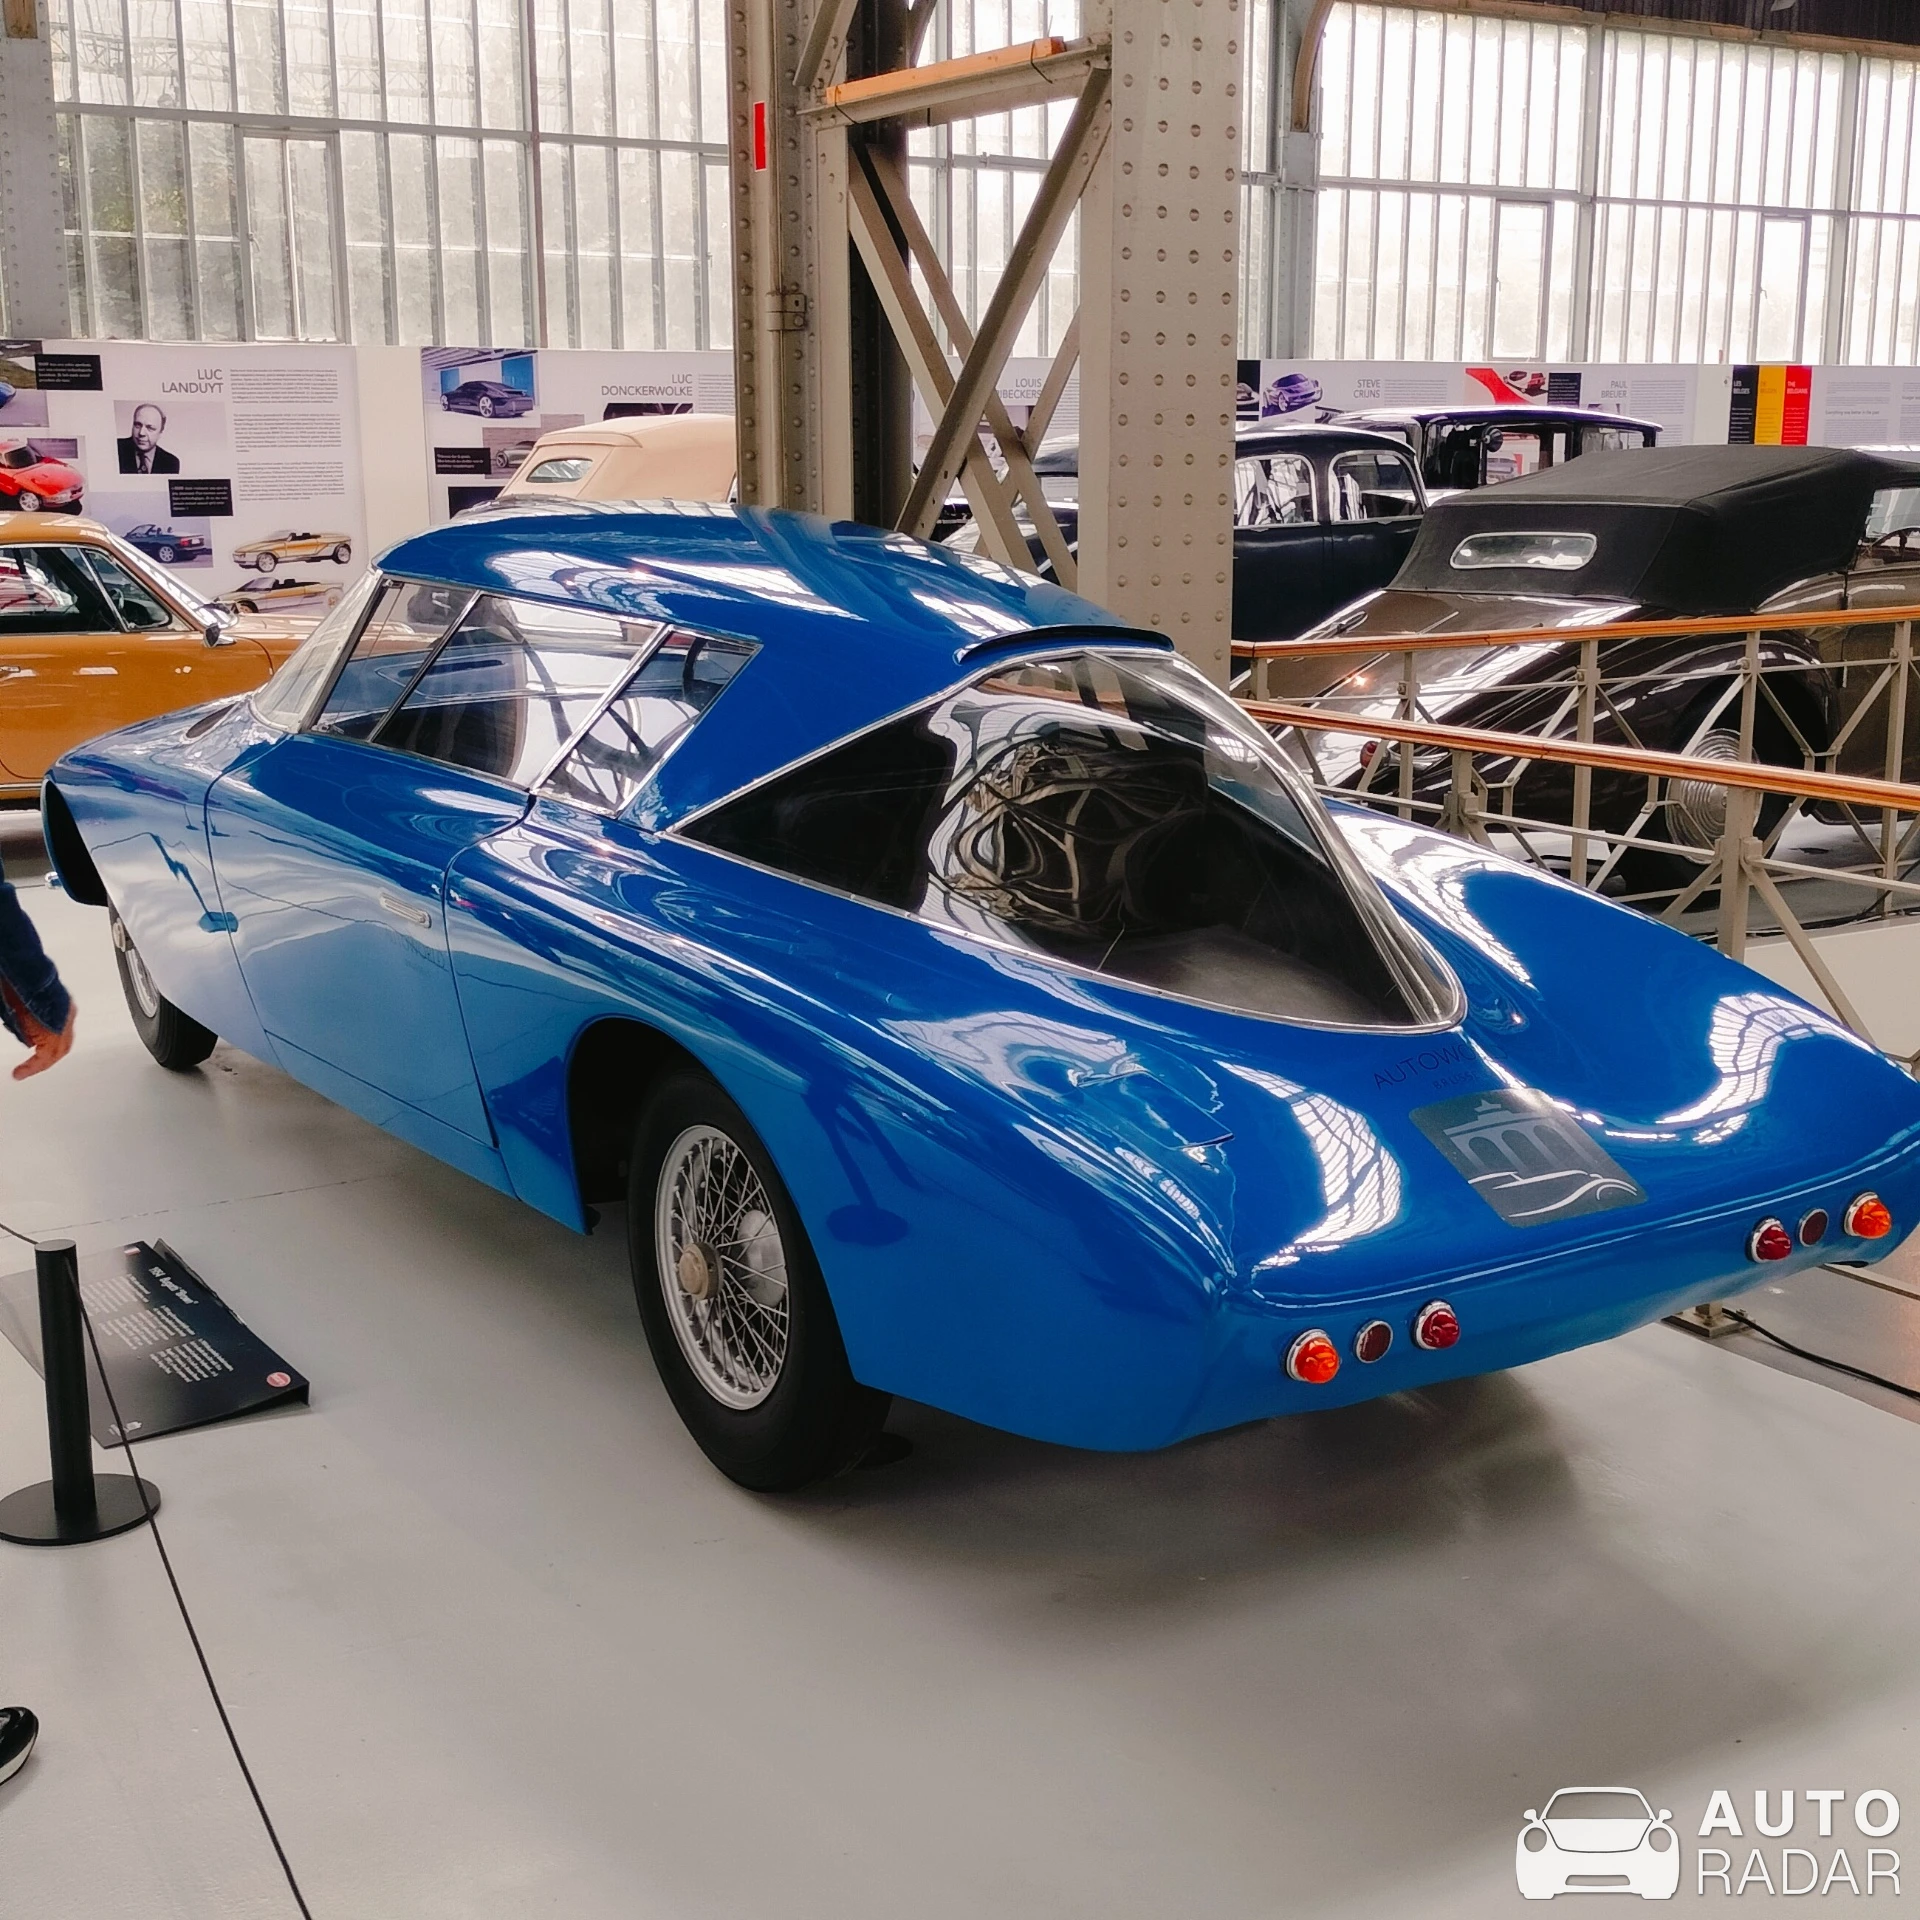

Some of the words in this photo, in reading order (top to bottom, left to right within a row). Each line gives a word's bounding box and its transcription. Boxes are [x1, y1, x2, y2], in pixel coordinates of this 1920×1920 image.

[197, 368, 223, 380] LUC
[671, 374, 693, 384] LUC
[162, 382, 224, 394] LANDUYT
[1015, 378, 1042, 388] LOUIS
[1357, 379, 1381, 388] STEVE
[1610, 380, 1627, 389] PAUL
[601, 385, 693, 397] DONCKERWOLKE
[1601, 390, 1627, 399] BREUER
